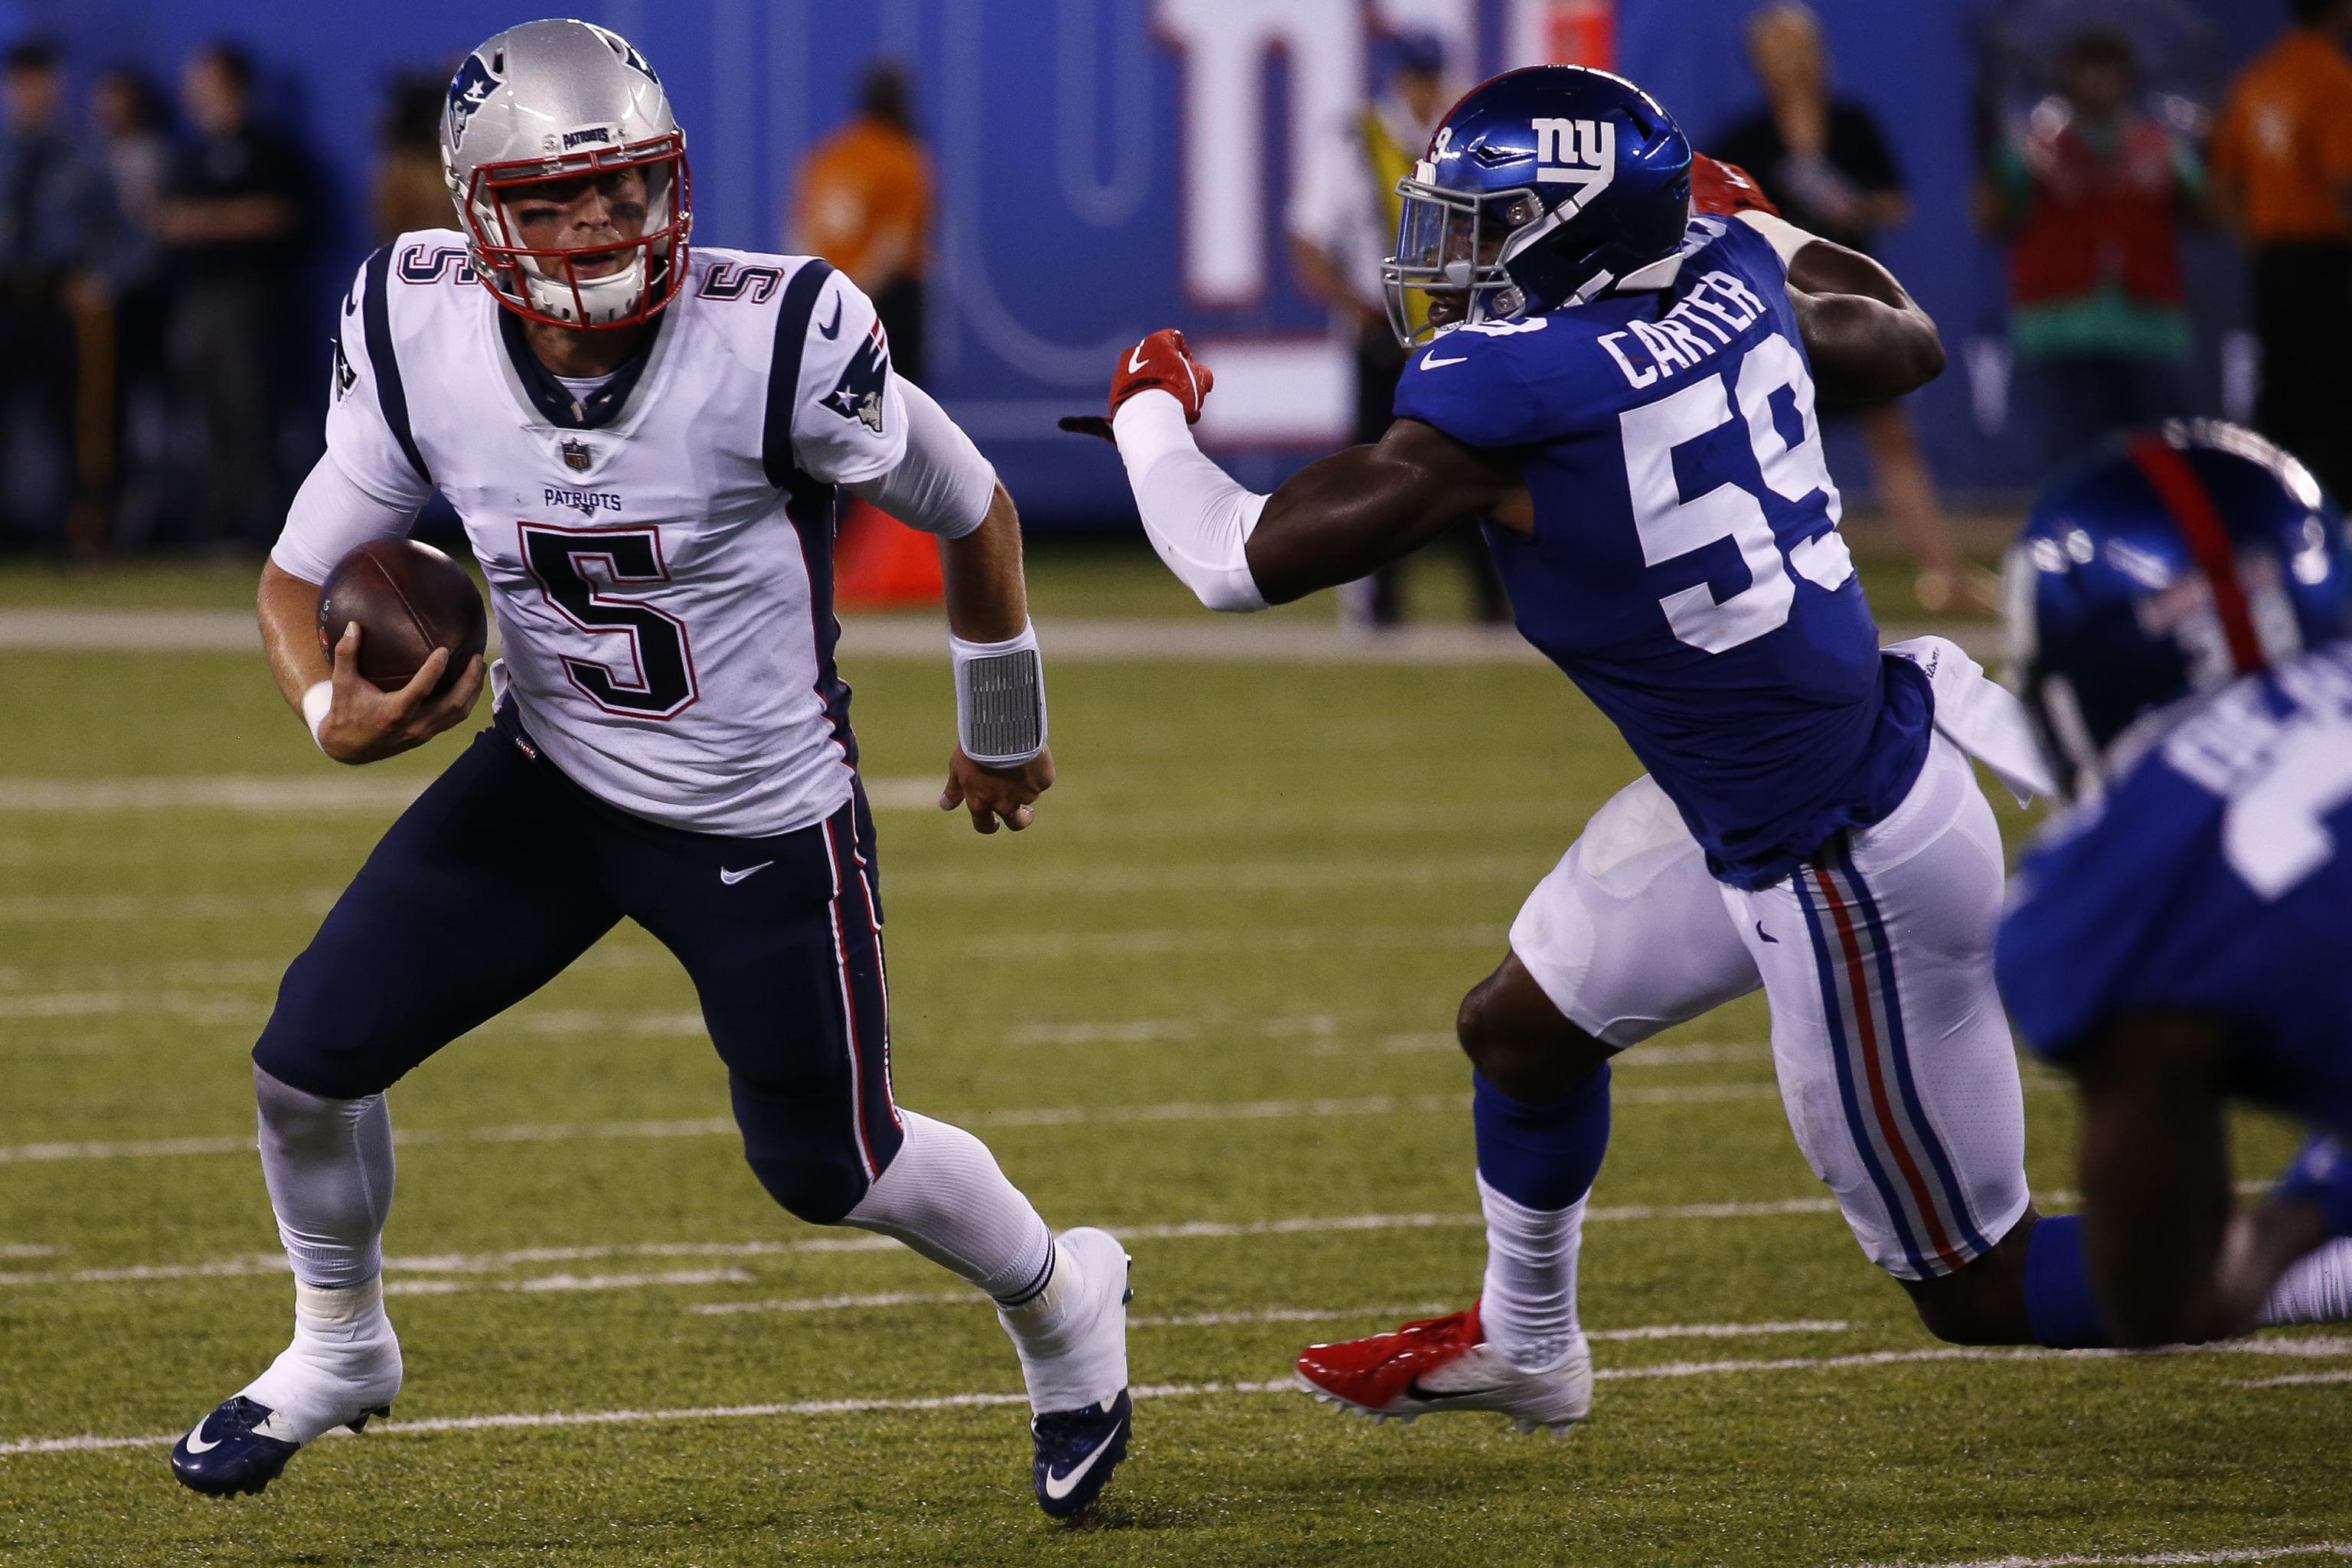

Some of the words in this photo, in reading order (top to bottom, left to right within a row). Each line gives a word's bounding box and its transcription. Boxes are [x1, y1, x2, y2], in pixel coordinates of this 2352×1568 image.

[562, 127, 609, 150] PATRIOTS
[1532, 118, 1615, 186] ny
[397, 243, 479, 285] 5
[694, 263, 785, 305] 5
[1597, 271, 1766, 389] CARTER
[544, 488, 622, 511] PATRIOTS
[1619, 332, 1854, 654] 59
[517, 521, 699, 721] 5
